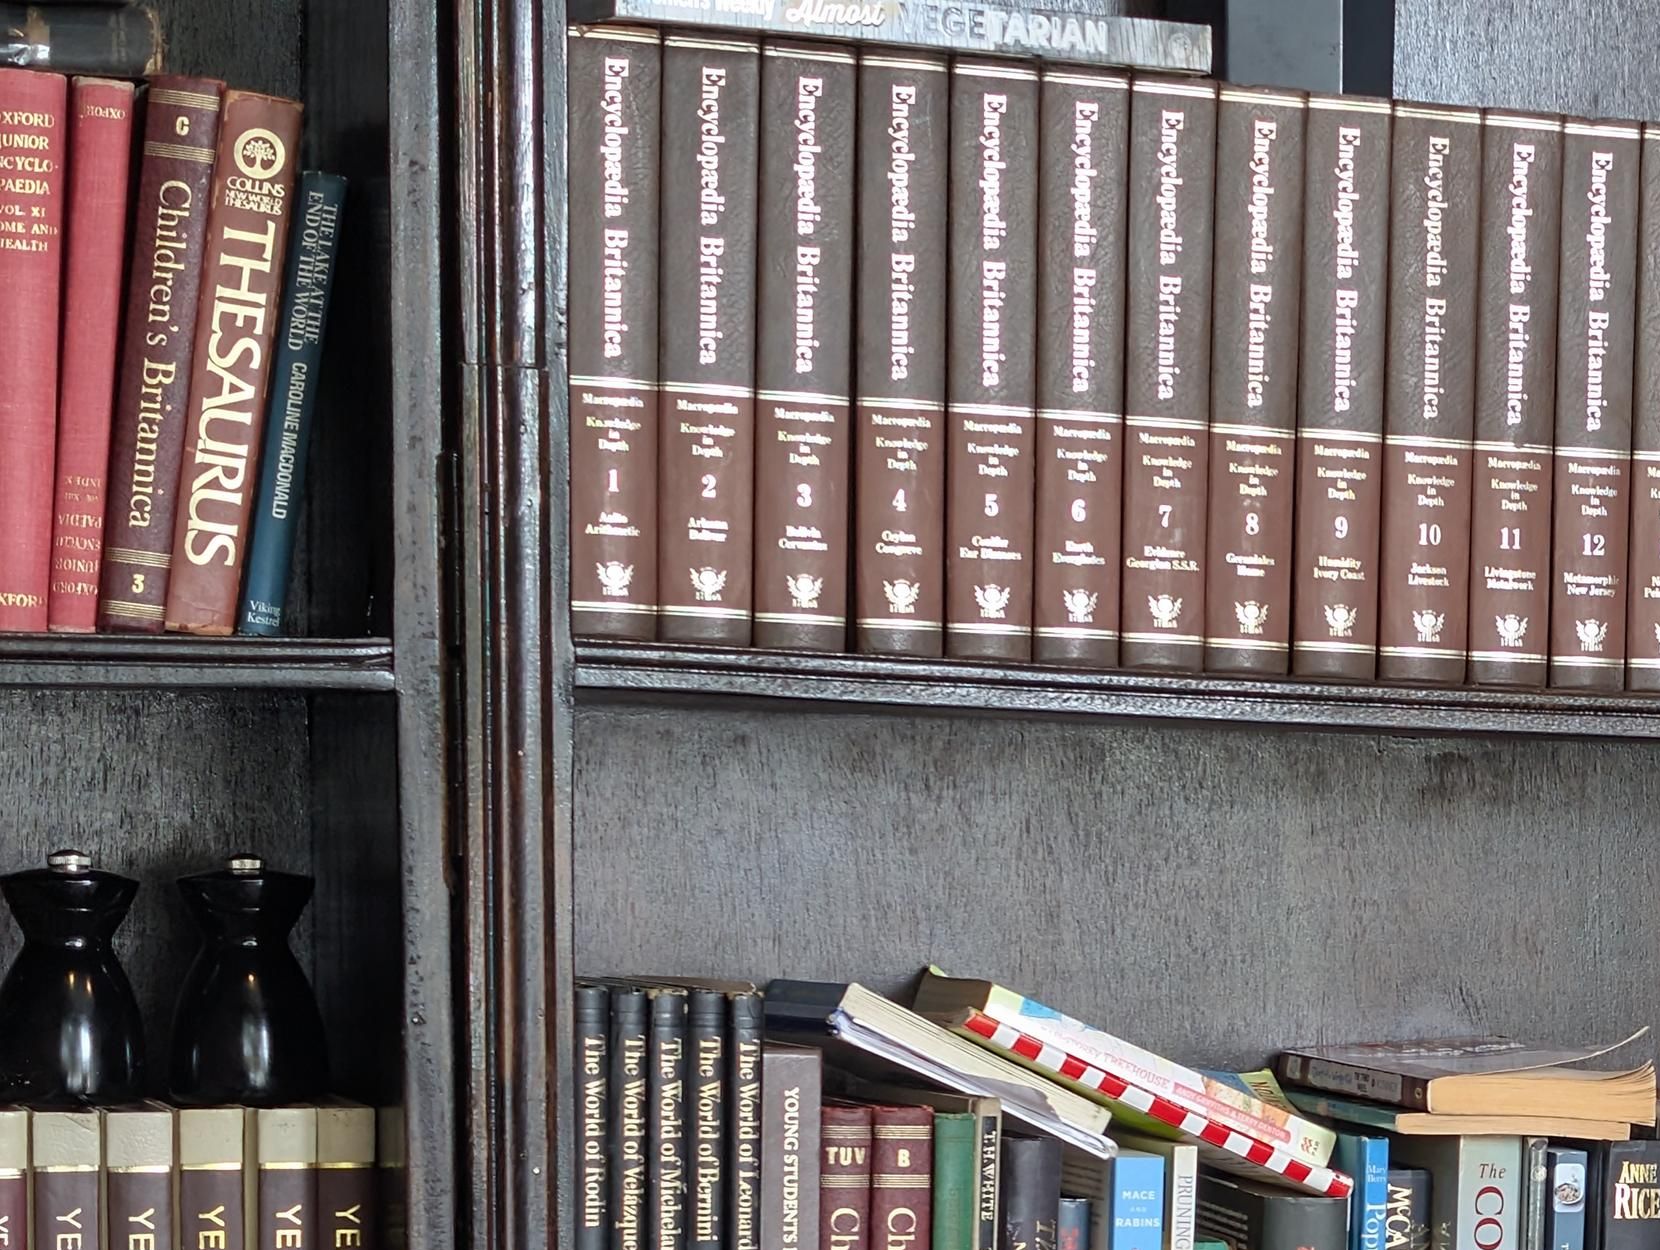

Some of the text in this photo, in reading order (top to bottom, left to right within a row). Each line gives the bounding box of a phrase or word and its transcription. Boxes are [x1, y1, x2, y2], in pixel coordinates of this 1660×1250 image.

[786, 1, 885, 26] Almost
[903, 4, 1109, 52] VEGETARIAN
[175, 117, 189, 137] C
[225, 189, 247, 202] NEW
[227, 176, 285, 198] COLLINS
[288, 191, 324, 351] END OF THE WORLD
[304, 204, 337, 344] THE LAKE AT THE
[603, 229, 630, 358] Britannica
[128, 178, 194, 531] Children's Britannica
[184, 221, 276, 567] THESAURUS
[272, 362, 307, 519] CAROLINE MACDONALD
[607, 471, 619, 491] 1
[131, 573, 145, 593] 3
[247, 612, 280, 626] Kestrel
[251, 600, 281, 616] Viking
[660, 1037, 682, 1079] The
[660, 1080, 682, 1139] World
[784, 1086, 799, 1150] YOUNG
[584, 1034, 605, 1227] The World of Rodin
[660, 1148, 682, 1167] of
[826, 1147, 865, 1166] TUV
[1479, 1163, 1507, 1178] The
[1619, 1161, 1657, 1183] ANNE
[783, 1154, 798, 1243] STUDENTS
[1122, 1190, 1156, 1200] MACE
[1174, 1174, 1193, 1250] PRUNING
[1614, 1183, 1660, 1220] RICE
[1115, 1217, 1160, 1228] RABINS
